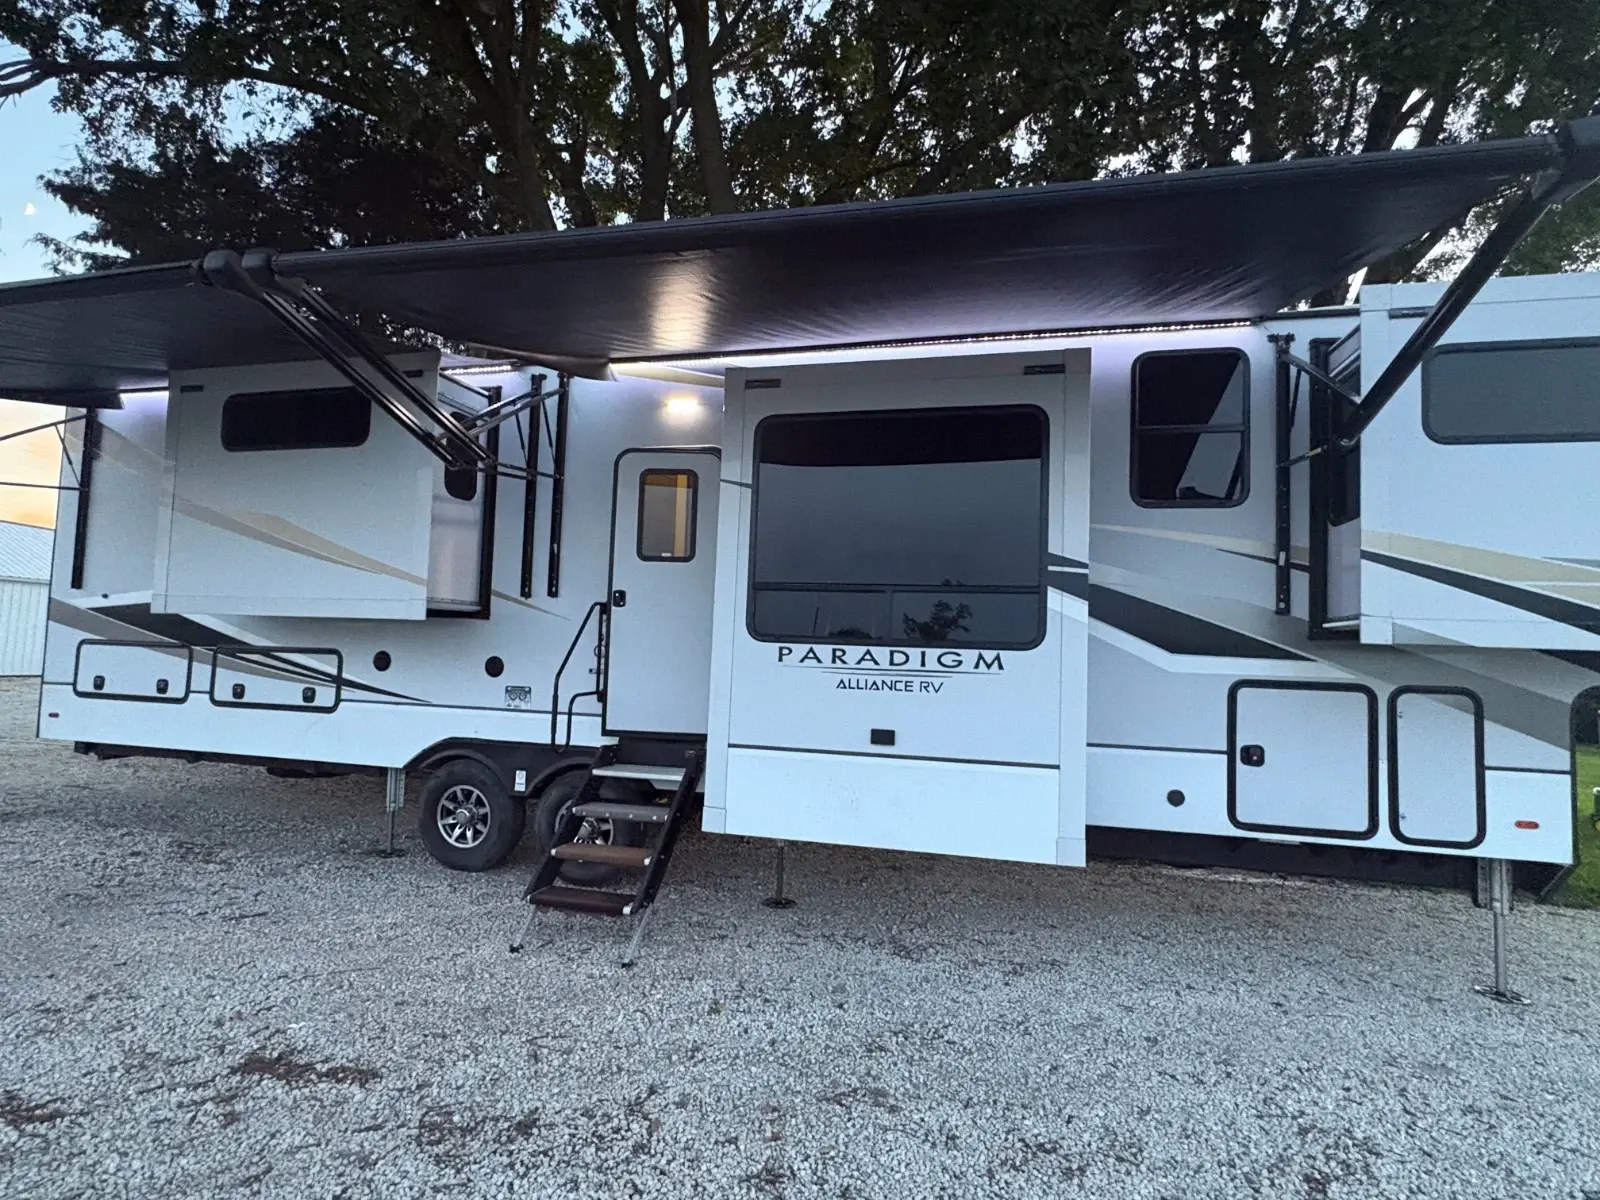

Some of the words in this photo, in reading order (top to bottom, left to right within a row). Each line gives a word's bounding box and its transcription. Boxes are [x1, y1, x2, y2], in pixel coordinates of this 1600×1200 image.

[777, 646, 1005, 671] PARADIGM
[836, 678, 914, 692] ALLIANCE
[919, 680, 944, 694] RV
